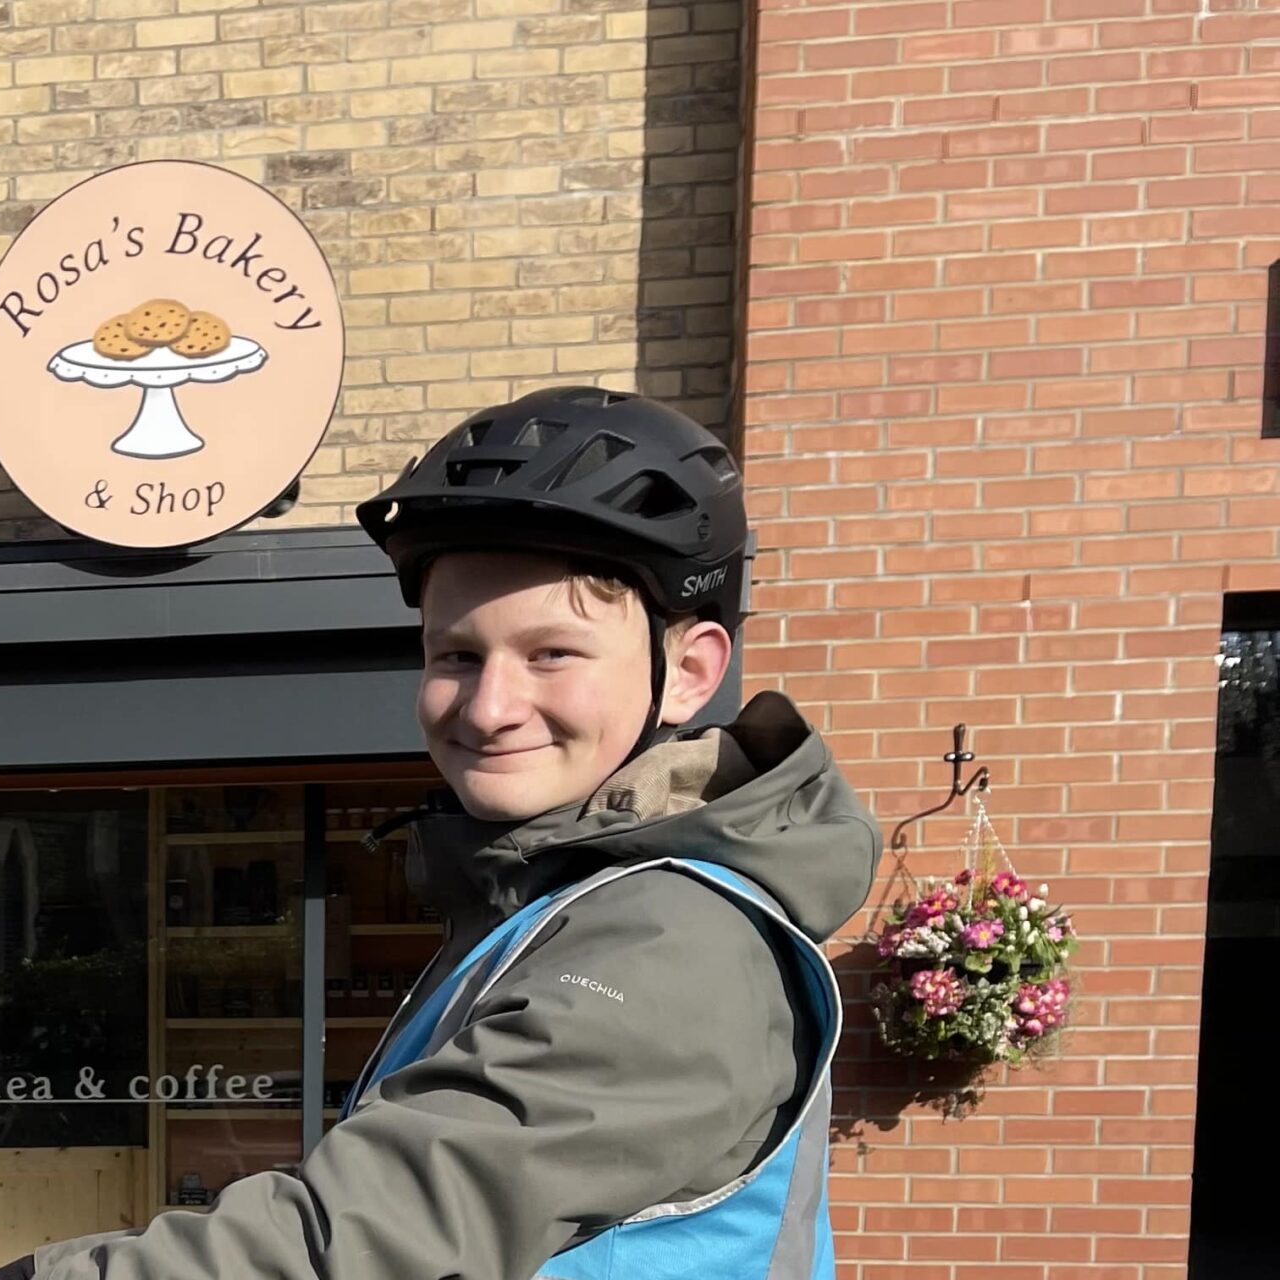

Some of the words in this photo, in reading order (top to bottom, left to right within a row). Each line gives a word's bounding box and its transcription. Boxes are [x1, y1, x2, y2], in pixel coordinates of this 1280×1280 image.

[165, 212, 322, 332] Bakery
[85, 479, 113, 510] &
[130, 480, 226, 515] Shop
[681, 565, 728, 598] SMITH
[560, 973, 625, 1003] QUECHUA
[75, 1066, 106, 1100] &
[128, 1064, 275, 1100] coffee
